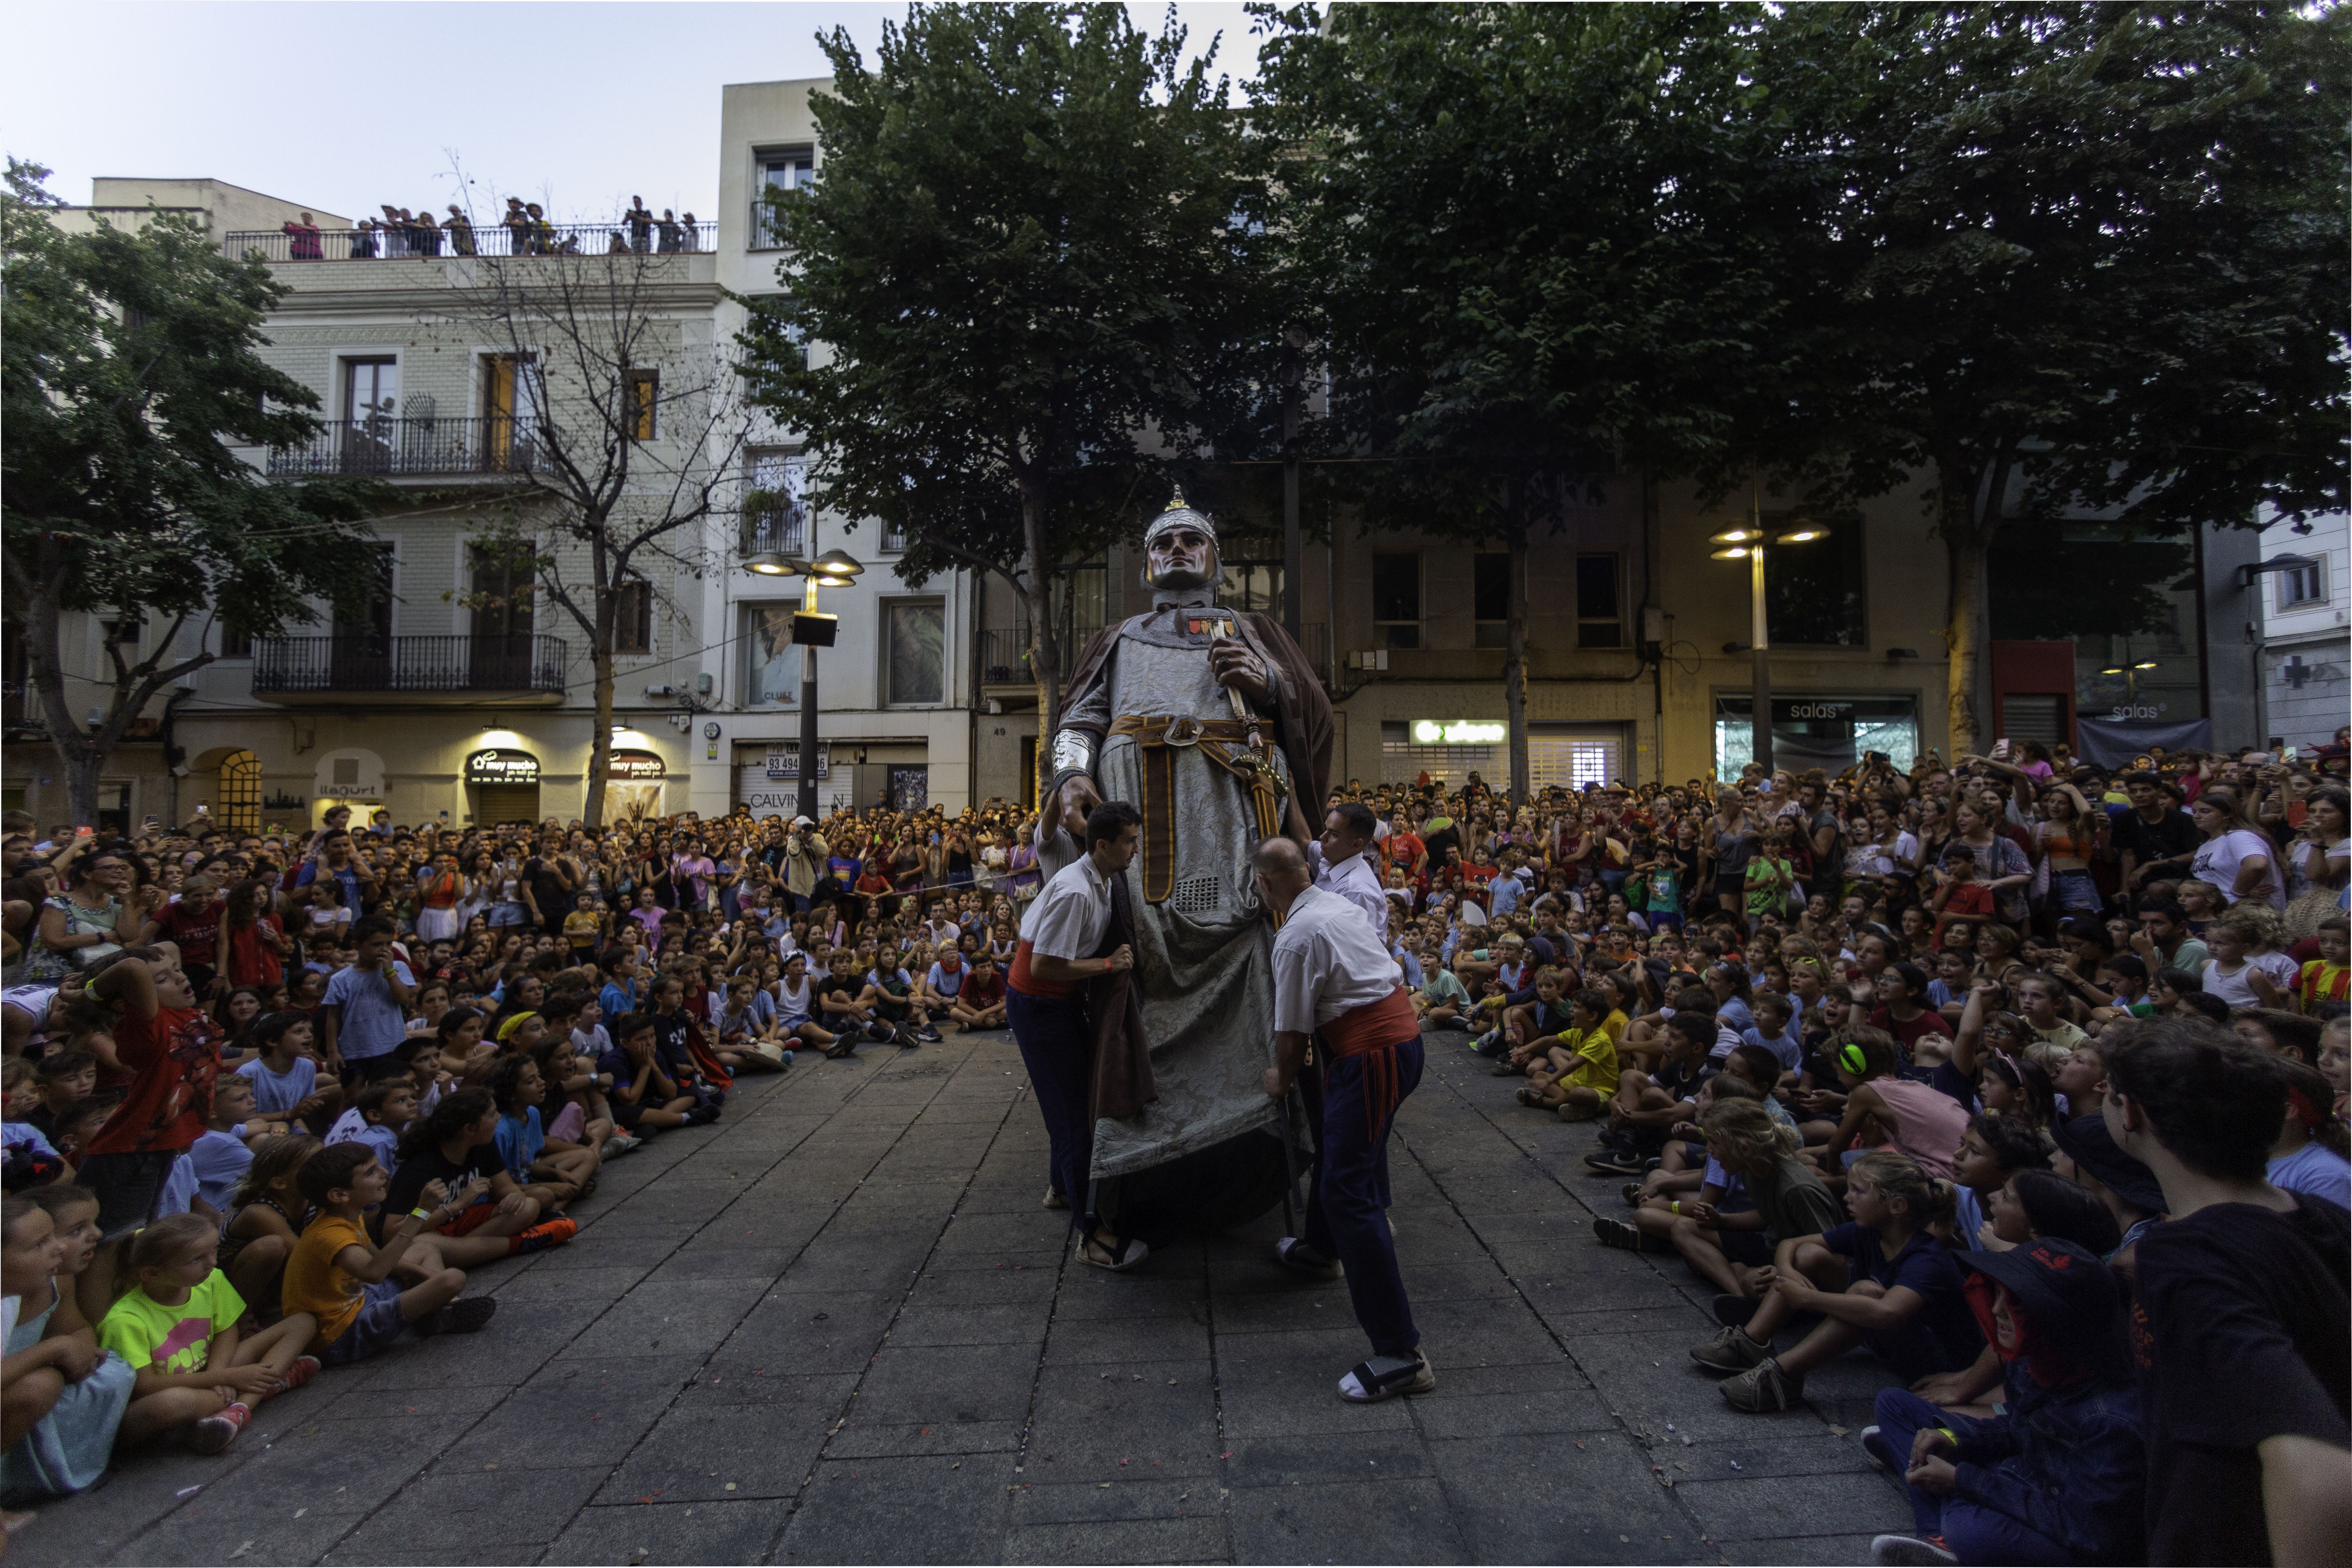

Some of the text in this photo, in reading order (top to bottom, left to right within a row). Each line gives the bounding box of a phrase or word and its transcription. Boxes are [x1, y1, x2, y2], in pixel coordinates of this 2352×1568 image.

[1790, 702, 1837, 719] salas
[994, 728, 1006, 736] 49
[486, 760, 537, 772] muy mucho
[610, 760, 662, 772] muy mucho
[769, 758, 798, 769] 93 494
[751, 793, 799, 808] CALVIN
